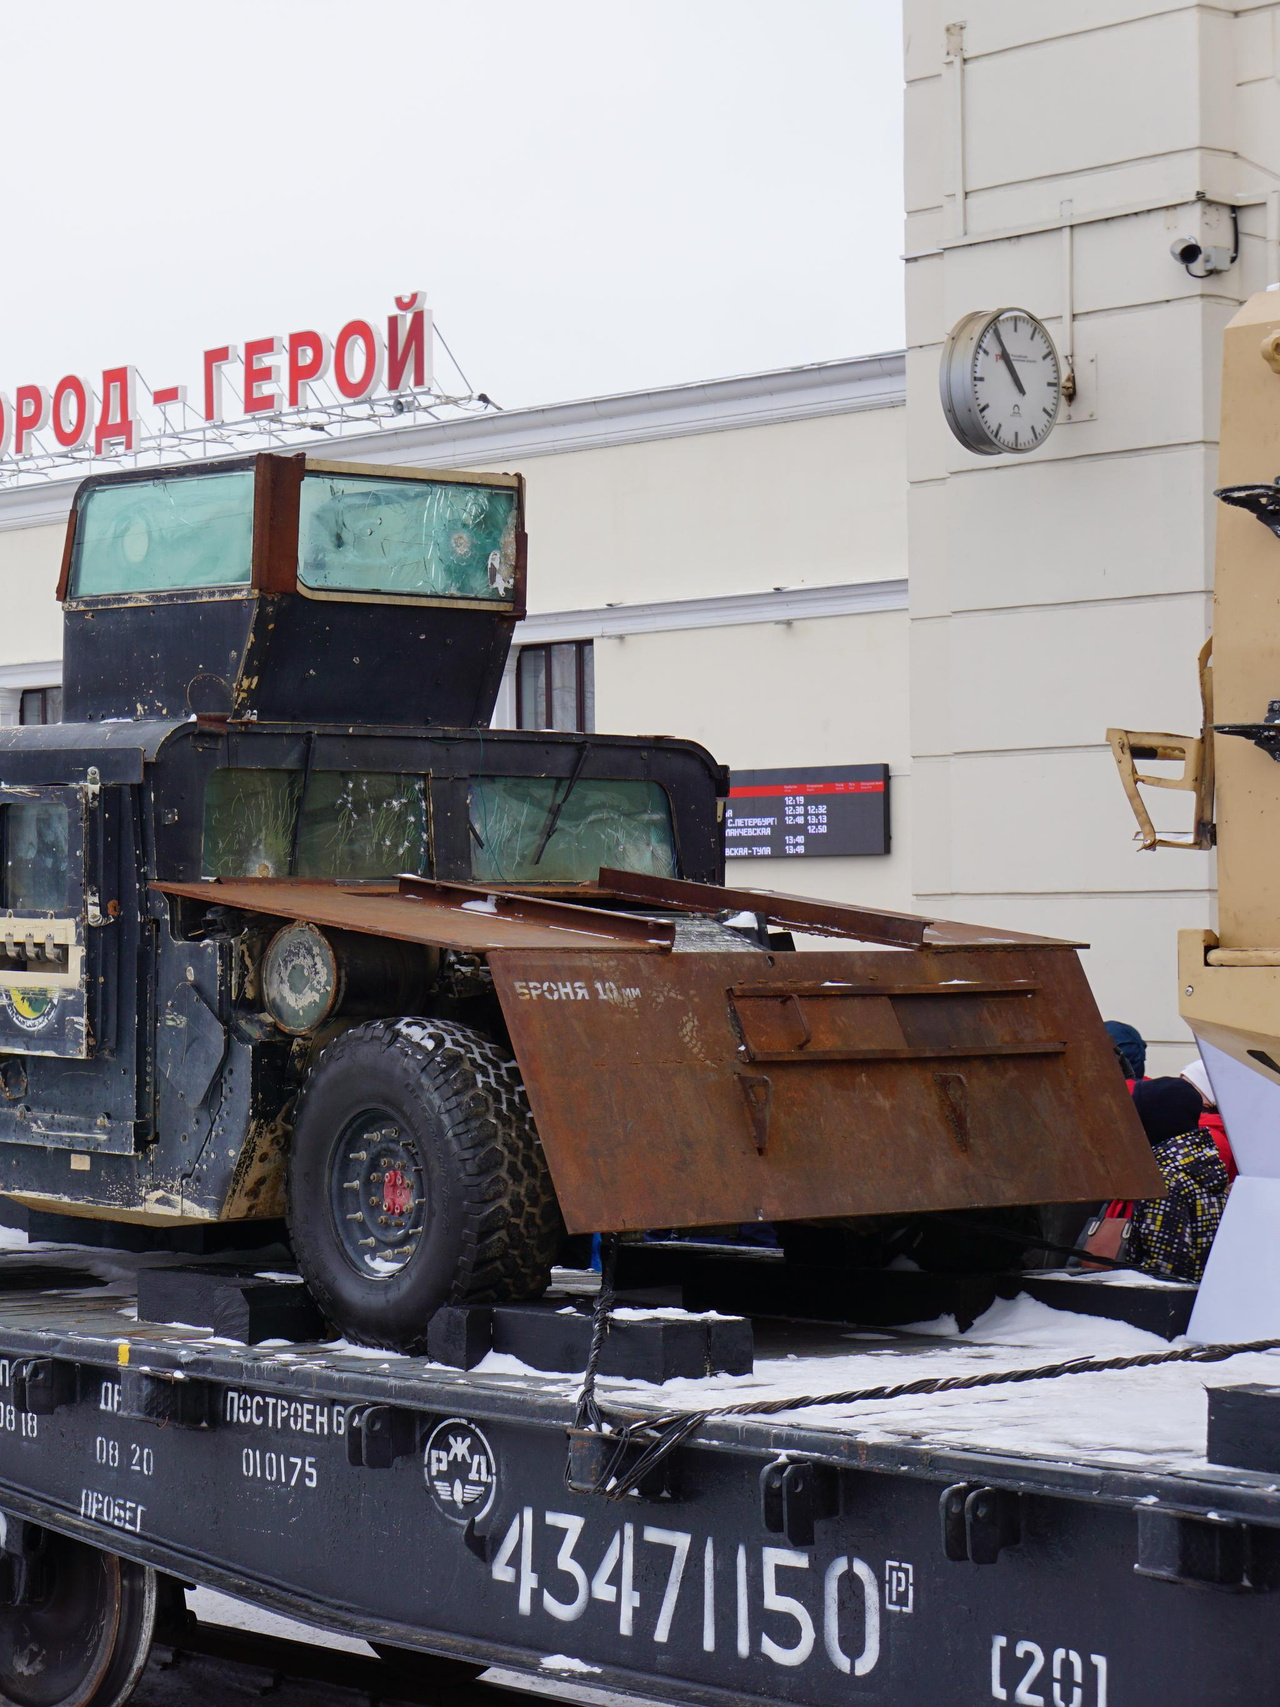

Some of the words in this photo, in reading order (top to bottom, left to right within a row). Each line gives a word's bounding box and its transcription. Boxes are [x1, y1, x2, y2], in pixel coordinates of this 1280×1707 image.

[203, 290, 434, 423] ГЕРОЙ
[784, 796, 804, 805] 12:19
[784, 806, 804, 815] 12:30
[807, 805, 827, 814] 12:32
[807, 815, 827, 823] 13:13
[807, 825, 827, 834] 12:50
[514, 981, 589, 1001] БРОНЯ
[594, 980, 620, 1001] 10
[226, 1391, 328, 1435] ПОСТРОЕН
[491, 1506, 881, 1675] 43471150
